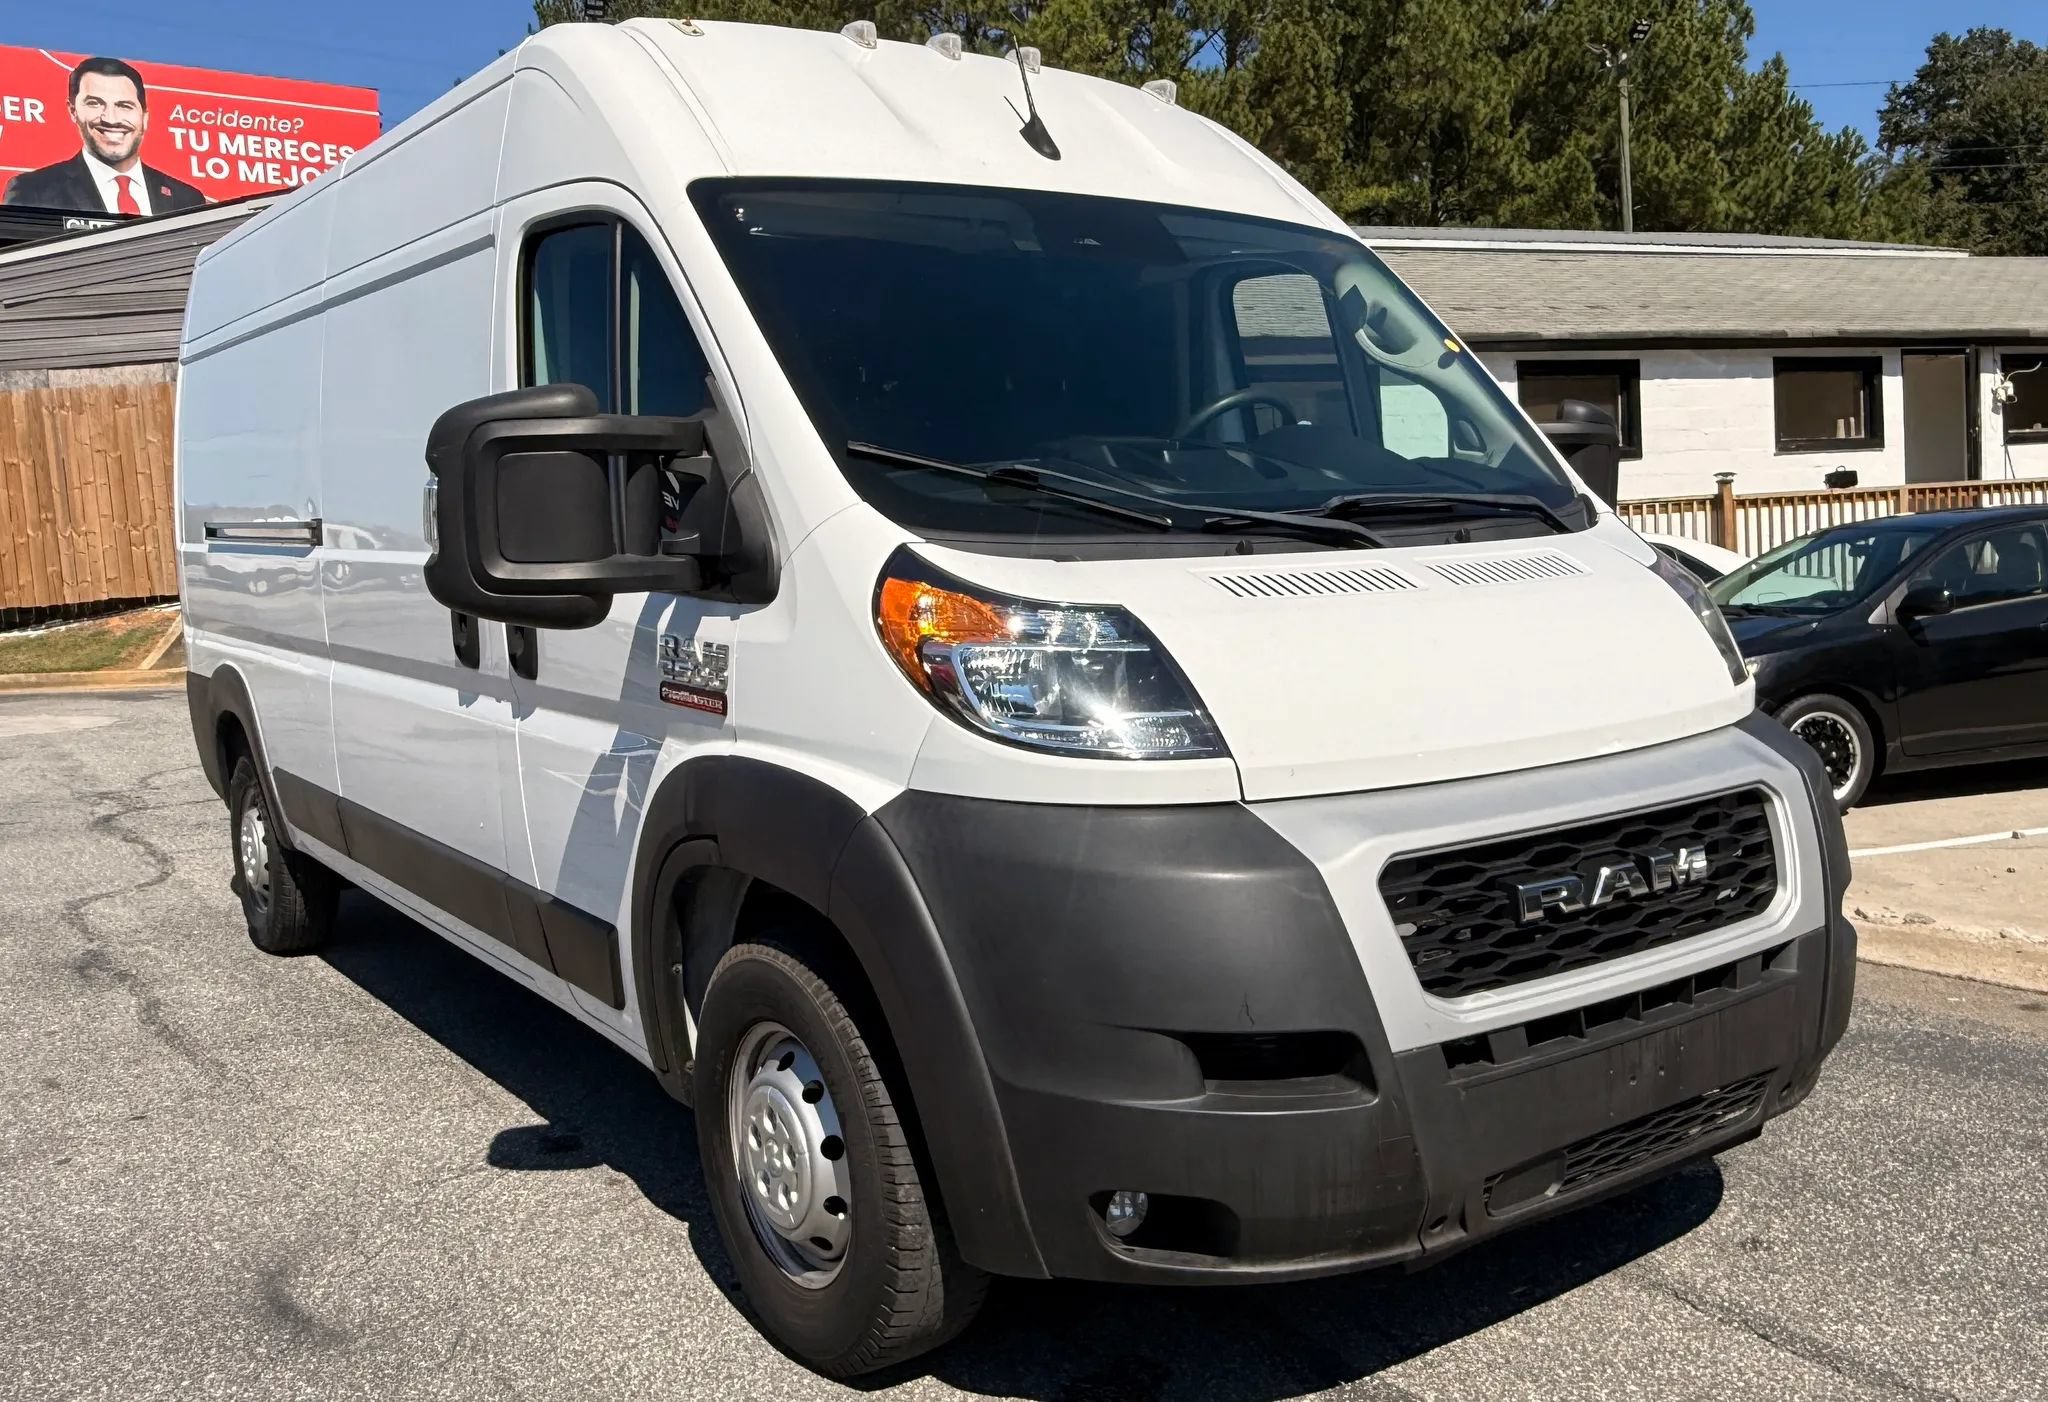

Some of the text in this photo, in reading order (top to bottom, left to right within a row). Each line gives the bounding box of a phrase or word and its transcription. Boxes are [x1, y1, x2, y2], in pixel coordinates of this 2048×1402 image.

[0, 95, 46, 124] ER
[169, 103, 304, 134] Accidente?
[167, 126, 356, 166] TU MERECES
[190, 154, 329, 187] LO MEJO
[1516, 845, 1708, 922] RAM
